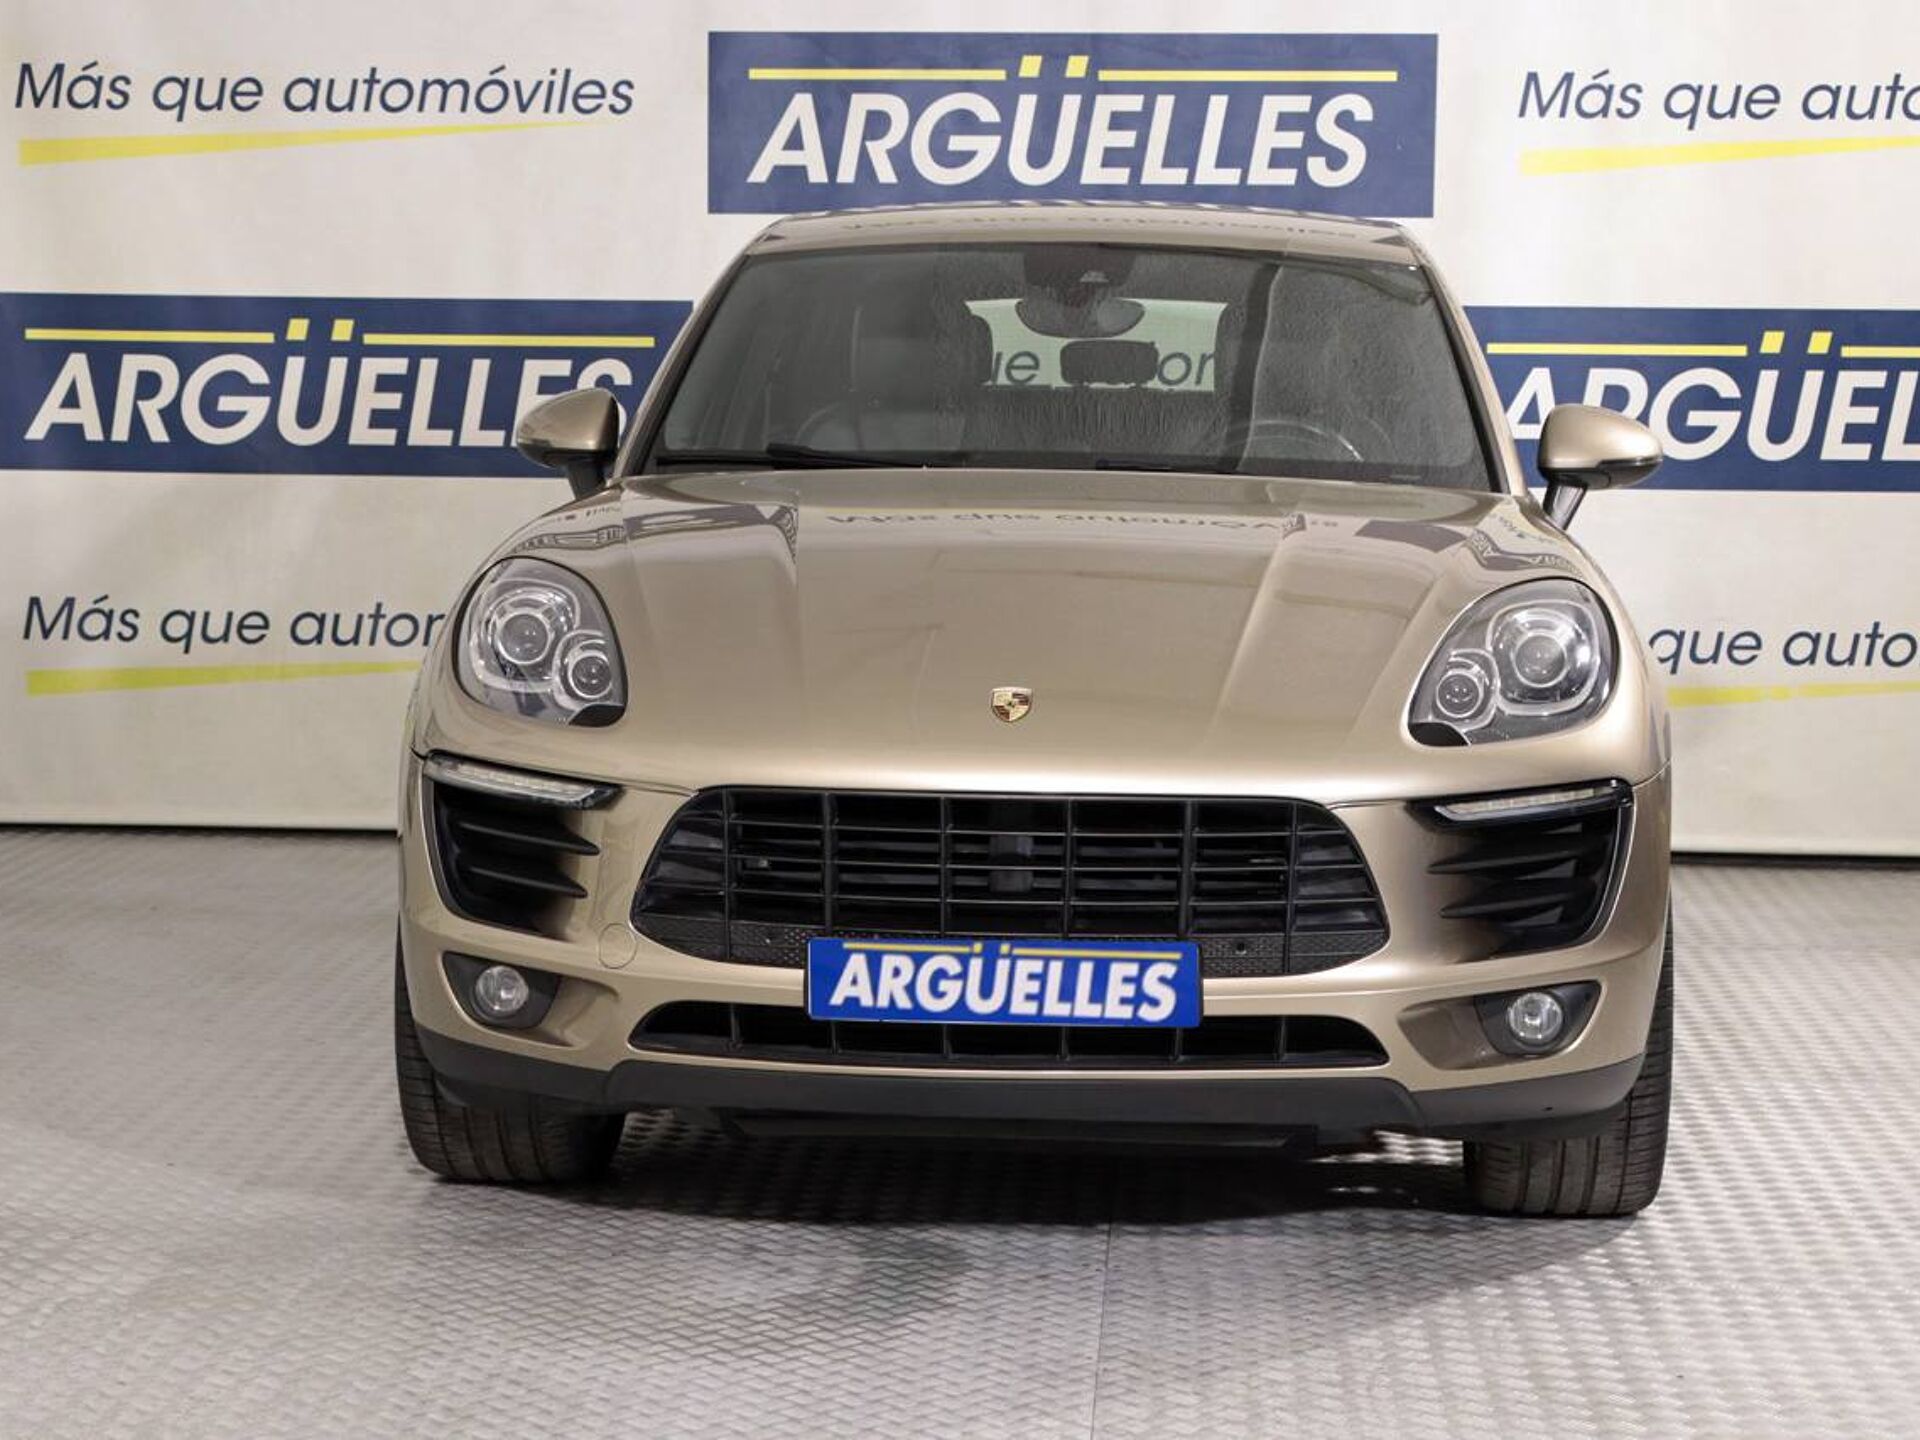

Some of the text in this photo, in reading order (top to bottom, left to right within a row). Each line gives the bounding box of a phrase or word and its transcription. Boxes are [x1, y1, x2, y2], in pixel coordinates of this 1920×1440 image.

[14, 60, 635, 123] Más que automóviles
[746, 55, 1374, 188] ARGÜELLES
[1517, 69, 1643, 119] Más
[1663, 83, 1781, 131] que
[22, 594, 141, 643] Más
[159, 609, 271, 655] que
[1648, 620, 1919, 676] que auto
[829, 943, 1178, 1022] ARGÜELLES
